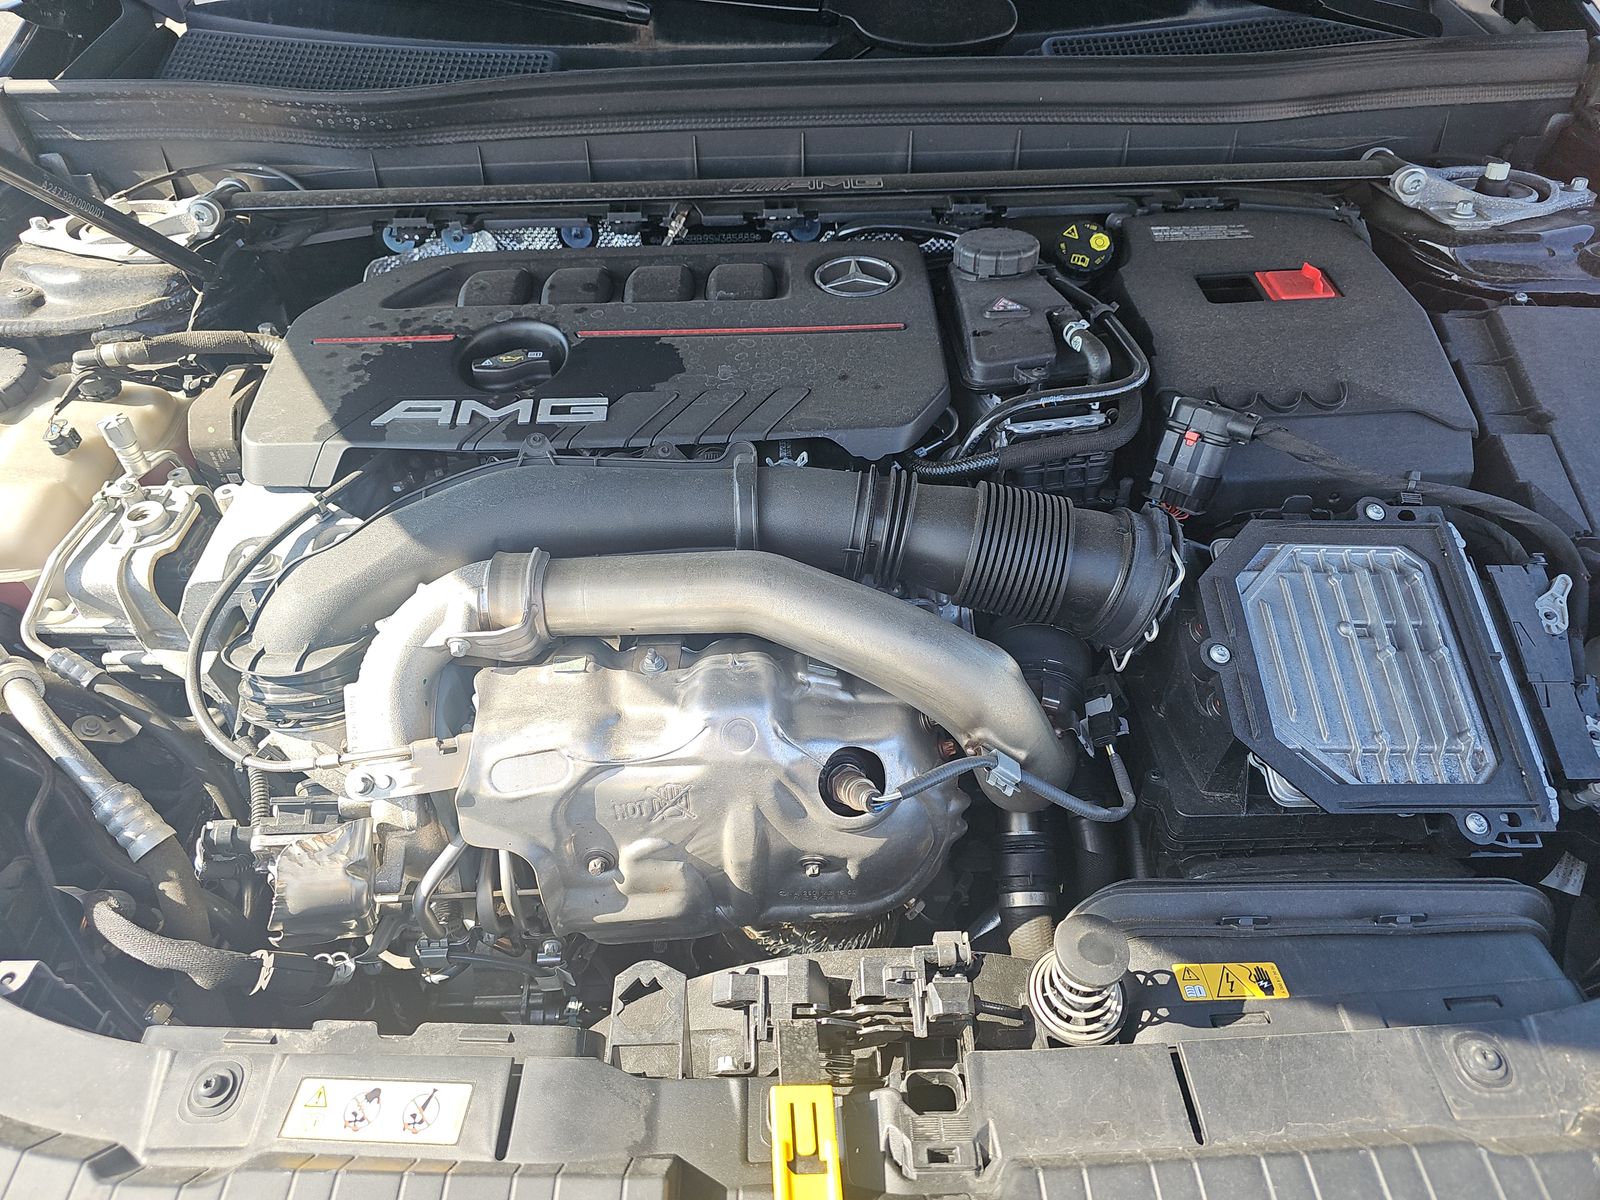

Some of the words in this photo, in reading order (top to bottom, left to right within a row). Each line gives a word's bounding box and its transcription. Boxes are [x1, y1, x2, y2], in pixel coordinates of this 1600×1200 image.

[782, 177, 884, 191] AMG
[62, 190, 76, 206] 980
[371, 398, 609, 426] AMG
